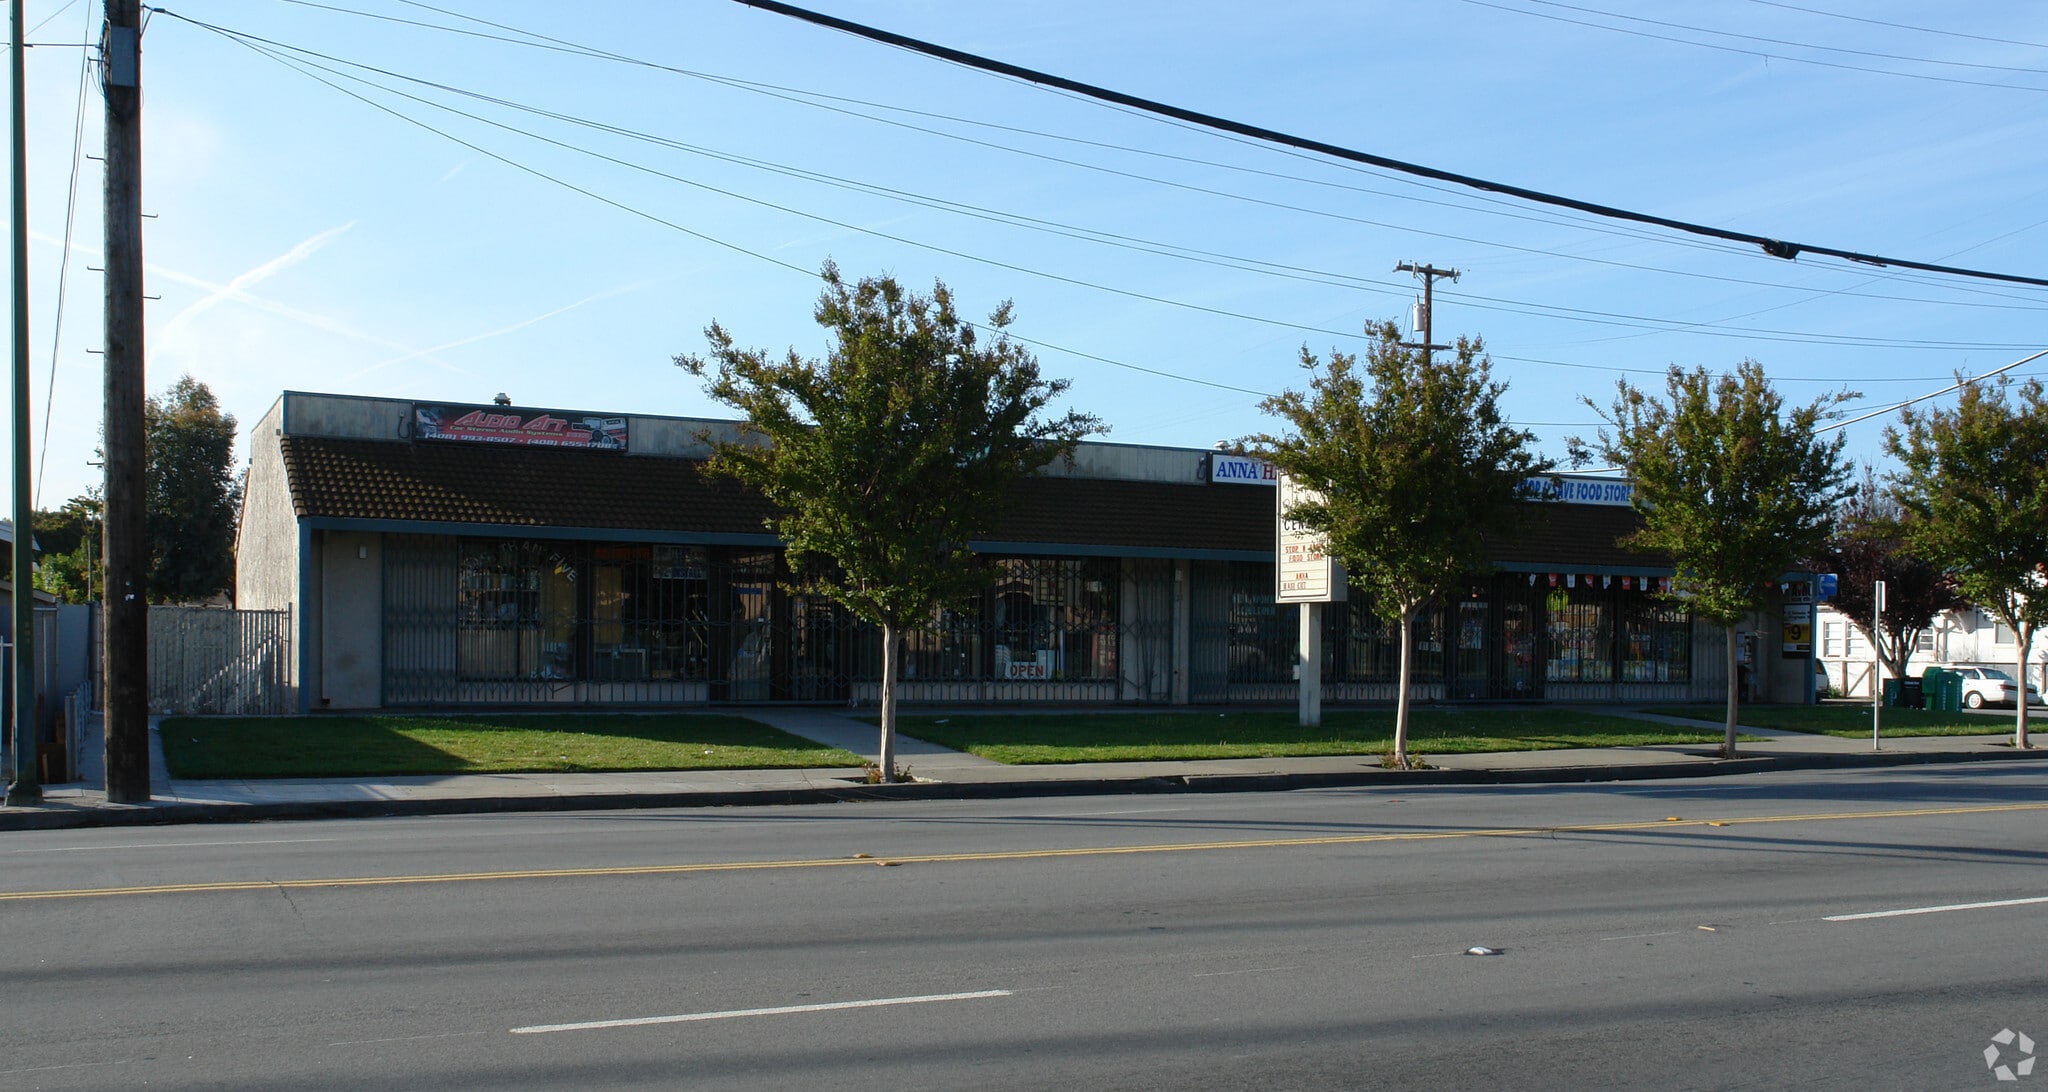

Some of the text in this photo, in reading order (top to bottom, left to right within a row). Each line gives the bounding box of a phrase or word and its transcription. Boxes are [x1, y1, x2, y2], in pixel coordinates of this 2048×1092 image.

[424, 432, 457, 440] (408)
[1216, 461, 1277, 480] ANNA H
[1576, 483, 1602, 500] FOOD
[1604, 485, 1631, 501] STORE
[549, 552, 578, 582] FIVE
[1010, 664, 1044, 676] OPEN
